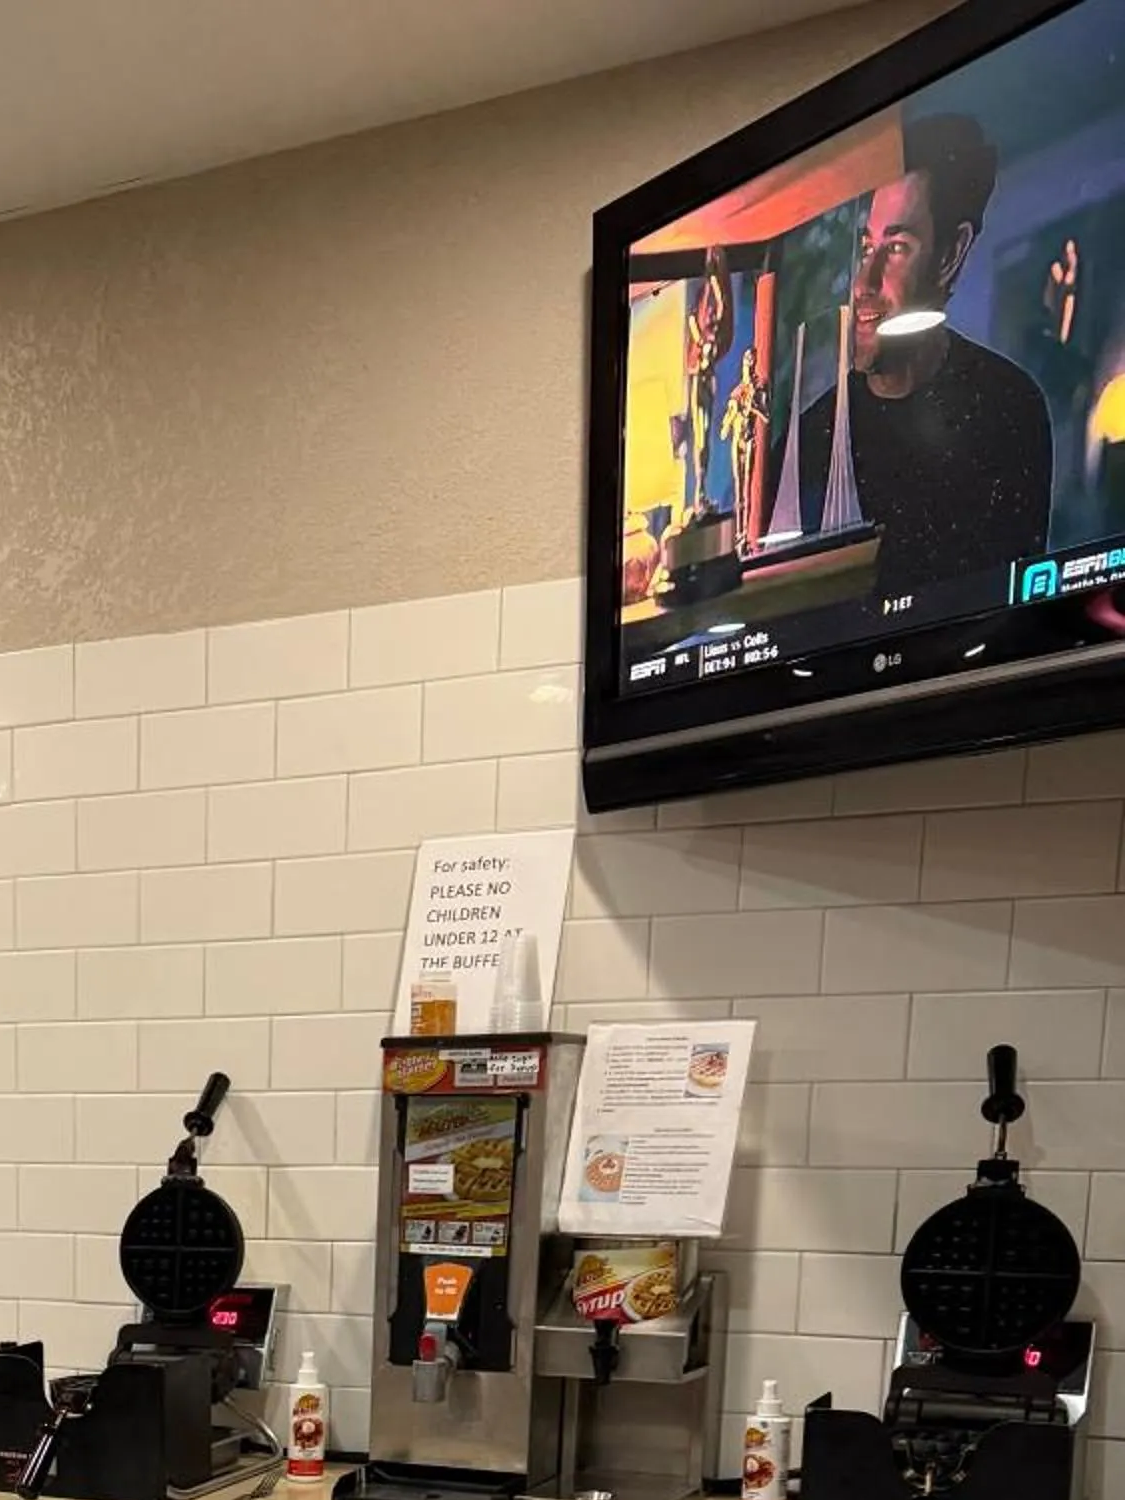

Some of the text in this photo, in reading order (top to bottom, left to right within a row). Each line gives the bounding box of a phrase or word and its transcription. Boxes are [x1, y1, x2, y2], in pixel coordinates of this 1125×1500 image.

[731, 640, 741, 651] vs
[744, 632, 769, 649] Colts
[888, 652, 902, 667] LG
[630, 657, 666, 681] ESPN
[434, 856, 511, 873] For safety:
[430, 881, 512, 900] PLEASE NO
[426, 905, 502, 923] CHILDREN
[424, 931, 476, 947] UNDER
[480, 929, 499, 944] 12
[452, 953, 501, 969] BUFFE
